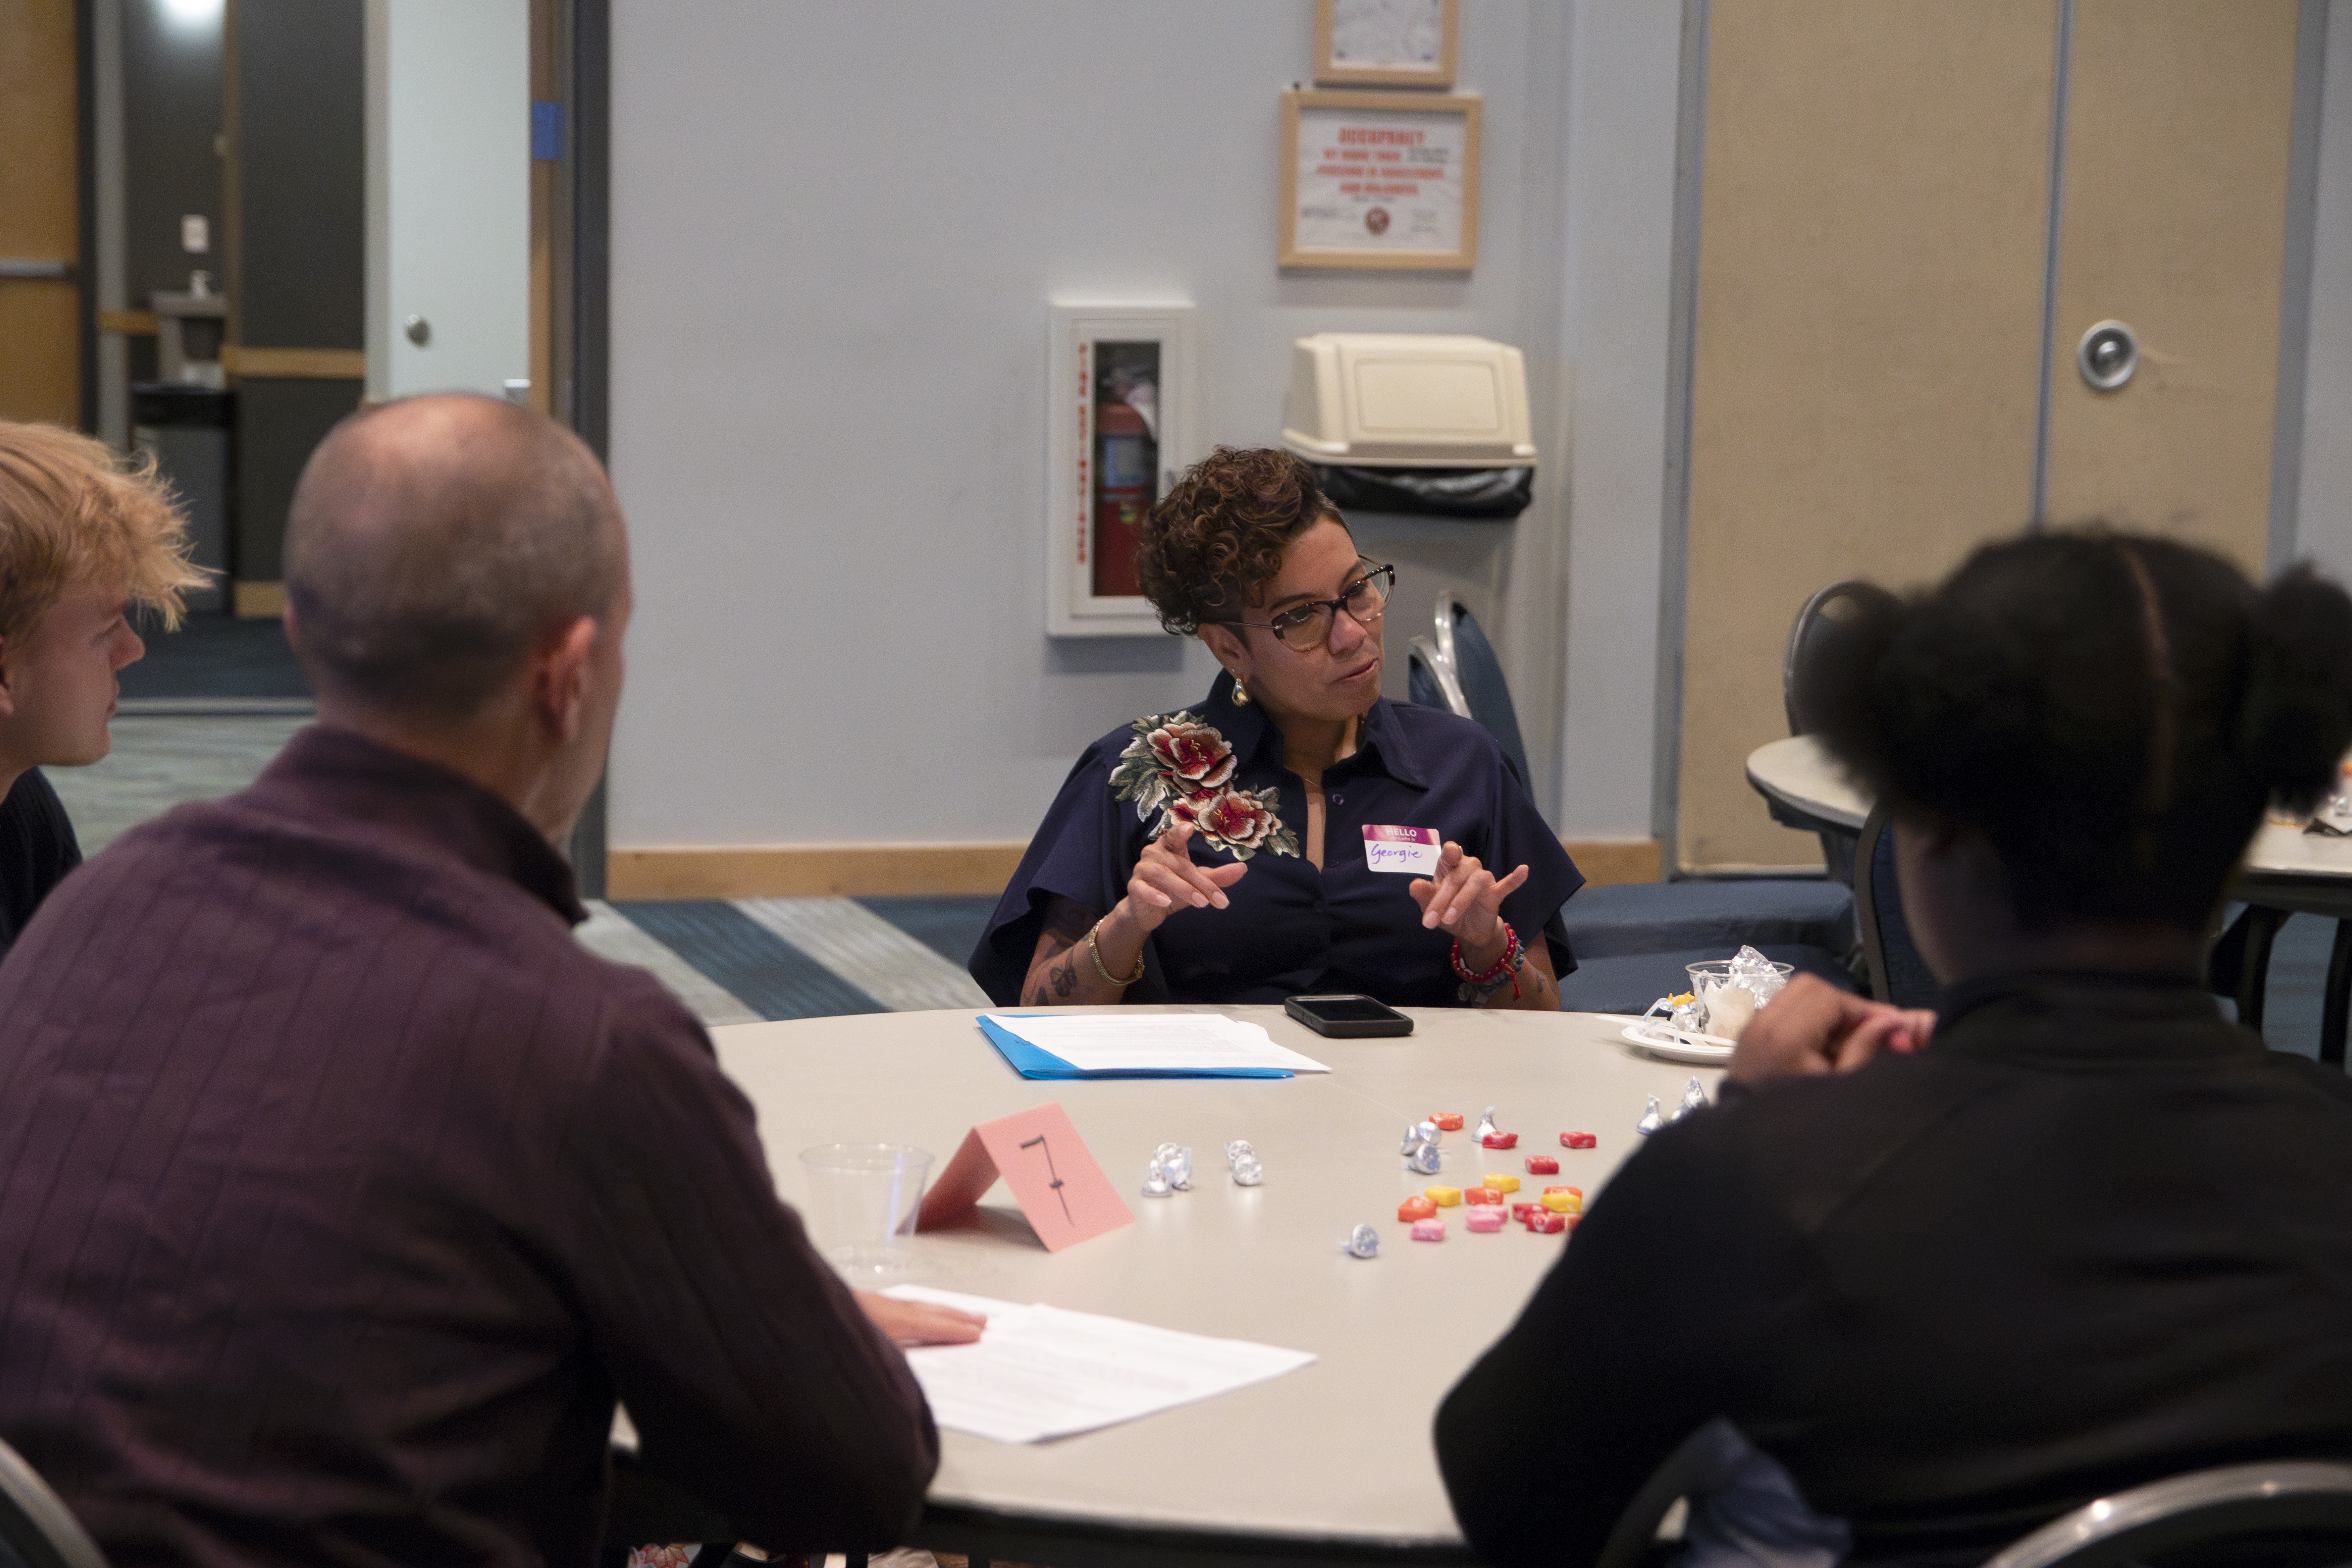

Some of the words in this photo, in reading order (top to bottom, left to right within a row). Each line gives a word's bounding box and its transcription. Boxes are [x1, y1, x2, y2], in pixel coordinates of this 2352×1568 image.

[1386, 828, 1417, 837] HELLO
[1371, 844, 1422, 864] Georgie
[1020, 1135, 1075, 1226] 7
